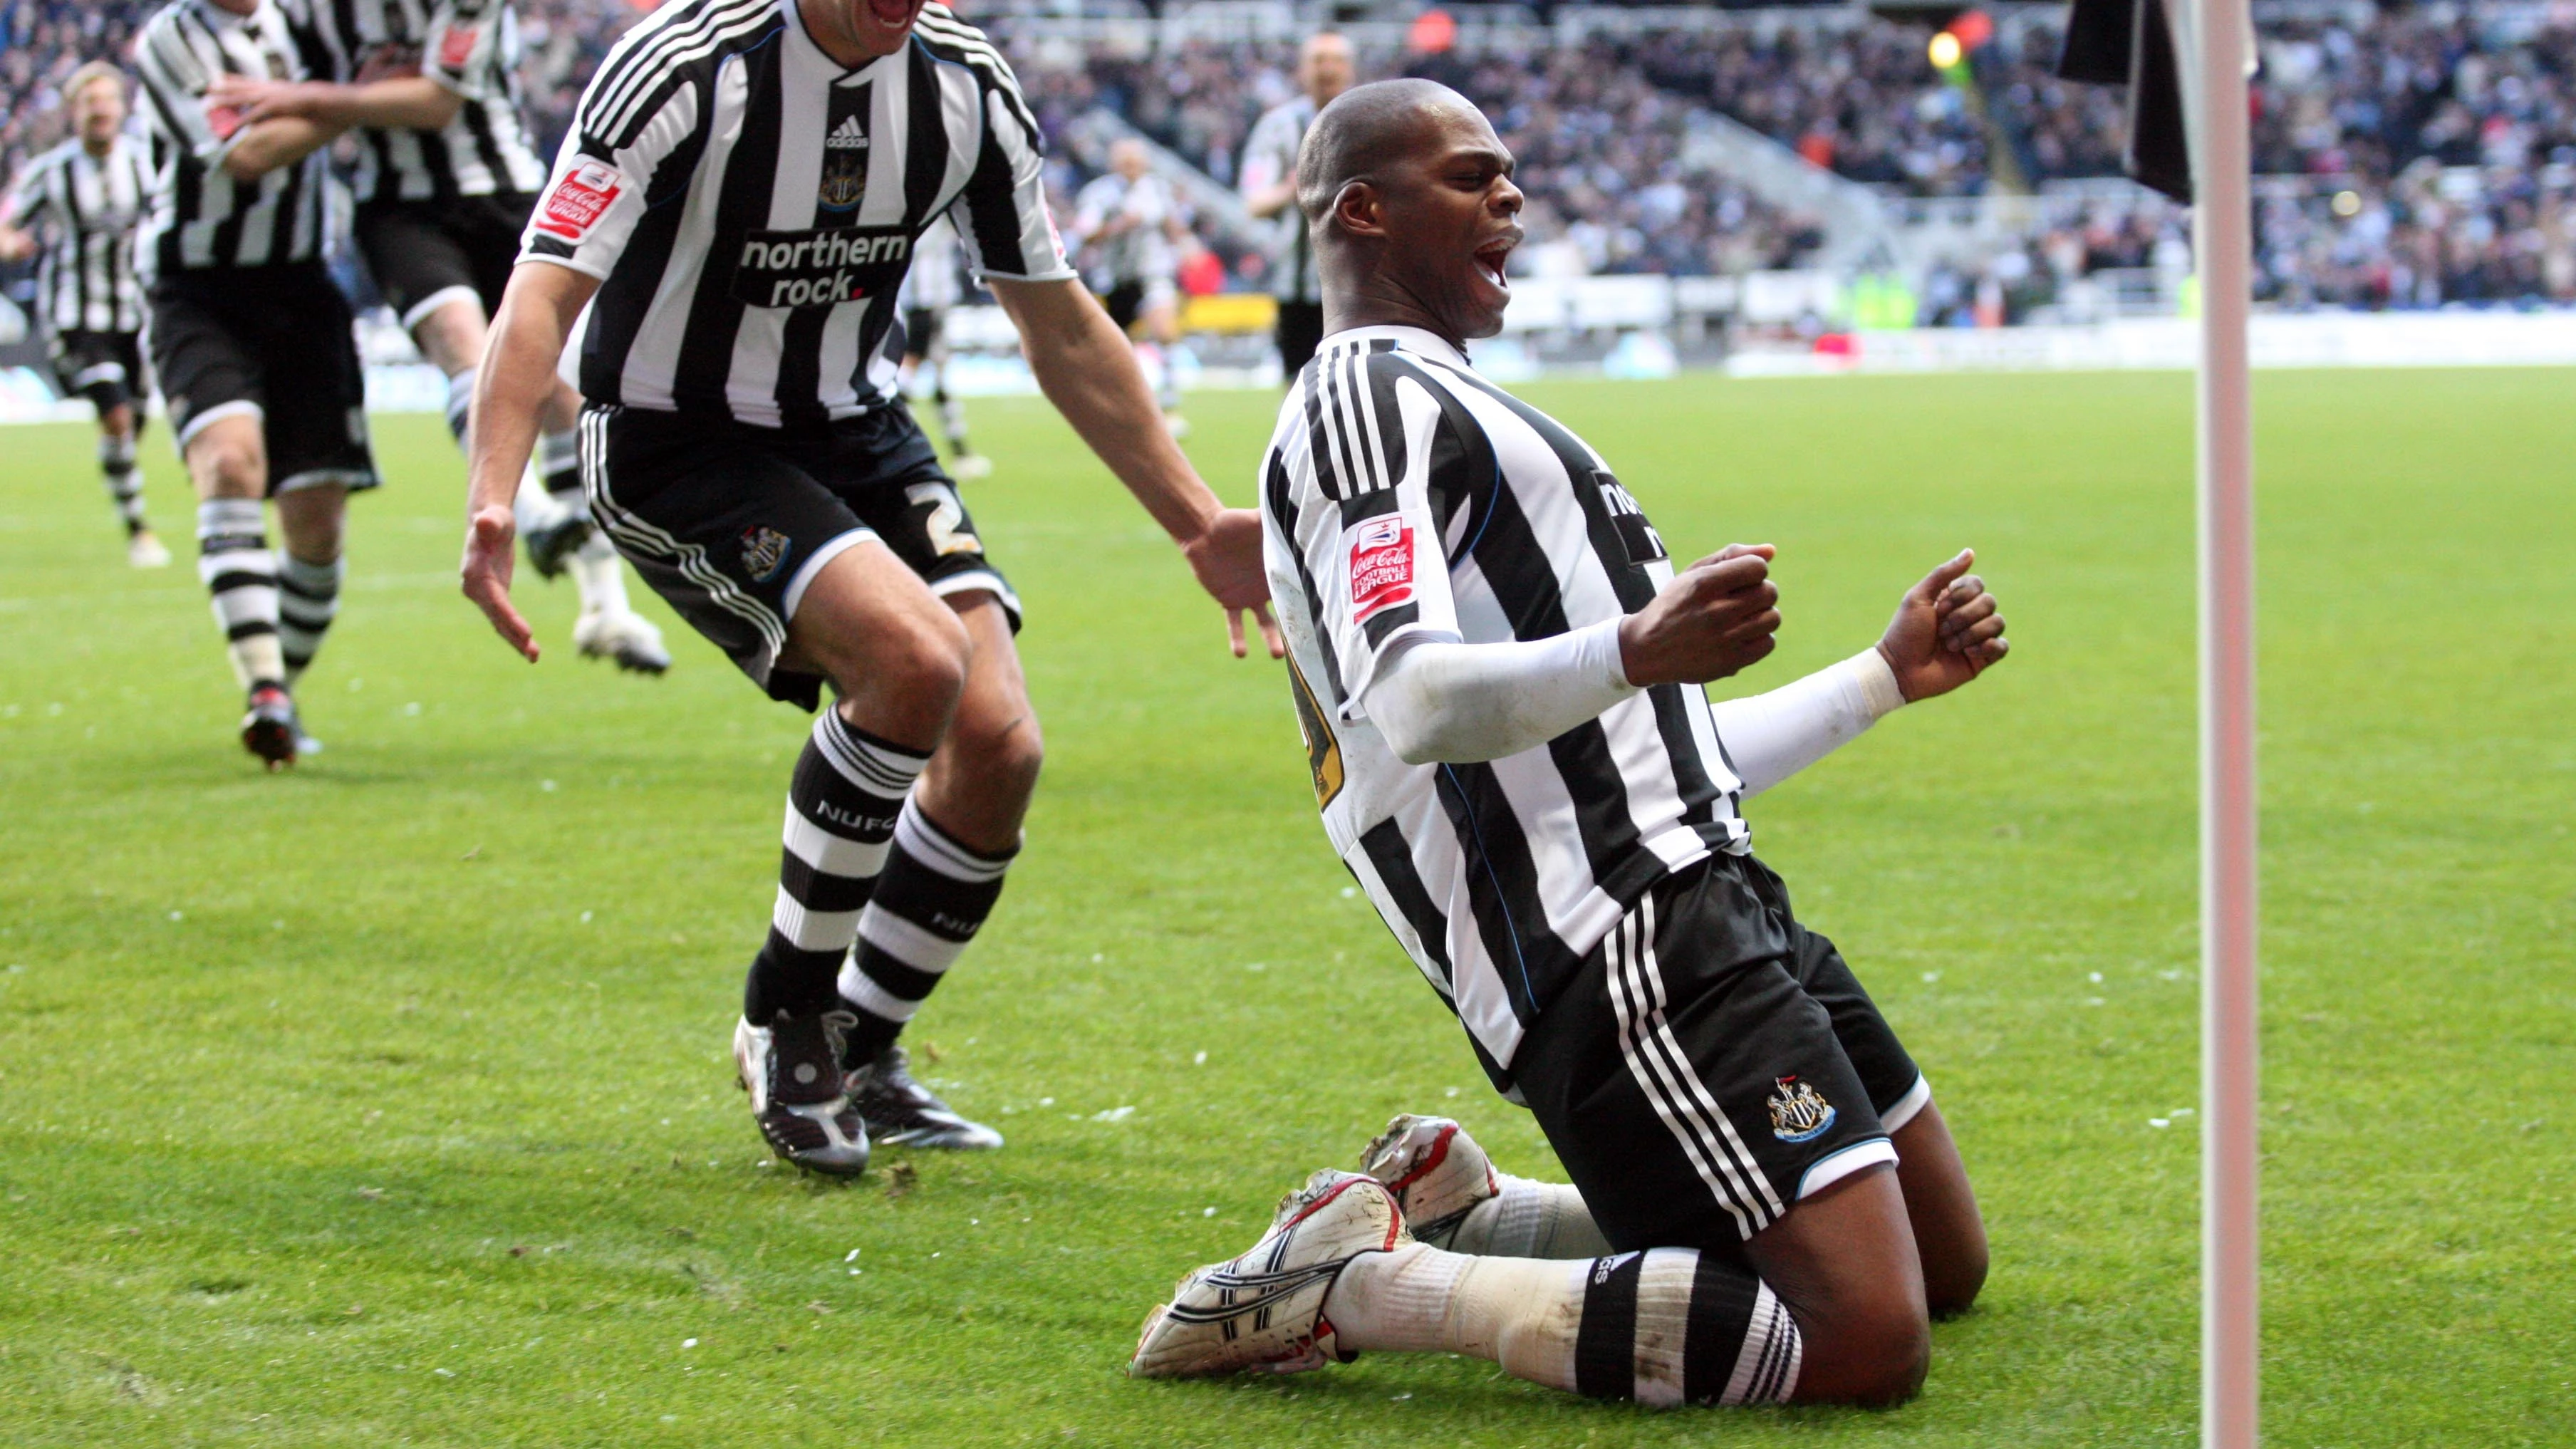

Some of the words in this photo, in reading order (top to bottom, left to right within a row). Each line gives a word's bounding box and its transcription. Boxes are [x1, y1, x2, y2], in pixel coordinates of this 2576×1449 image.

[826, 137, 869, 148] adidas
[741, 231, 908, 269] northern
[1353, 544, 1411, 578] Coca-Cola
[1355, 564, 1408, 590] FOOTBALL
[1356, 573, 1408, 600] LEAGUE
